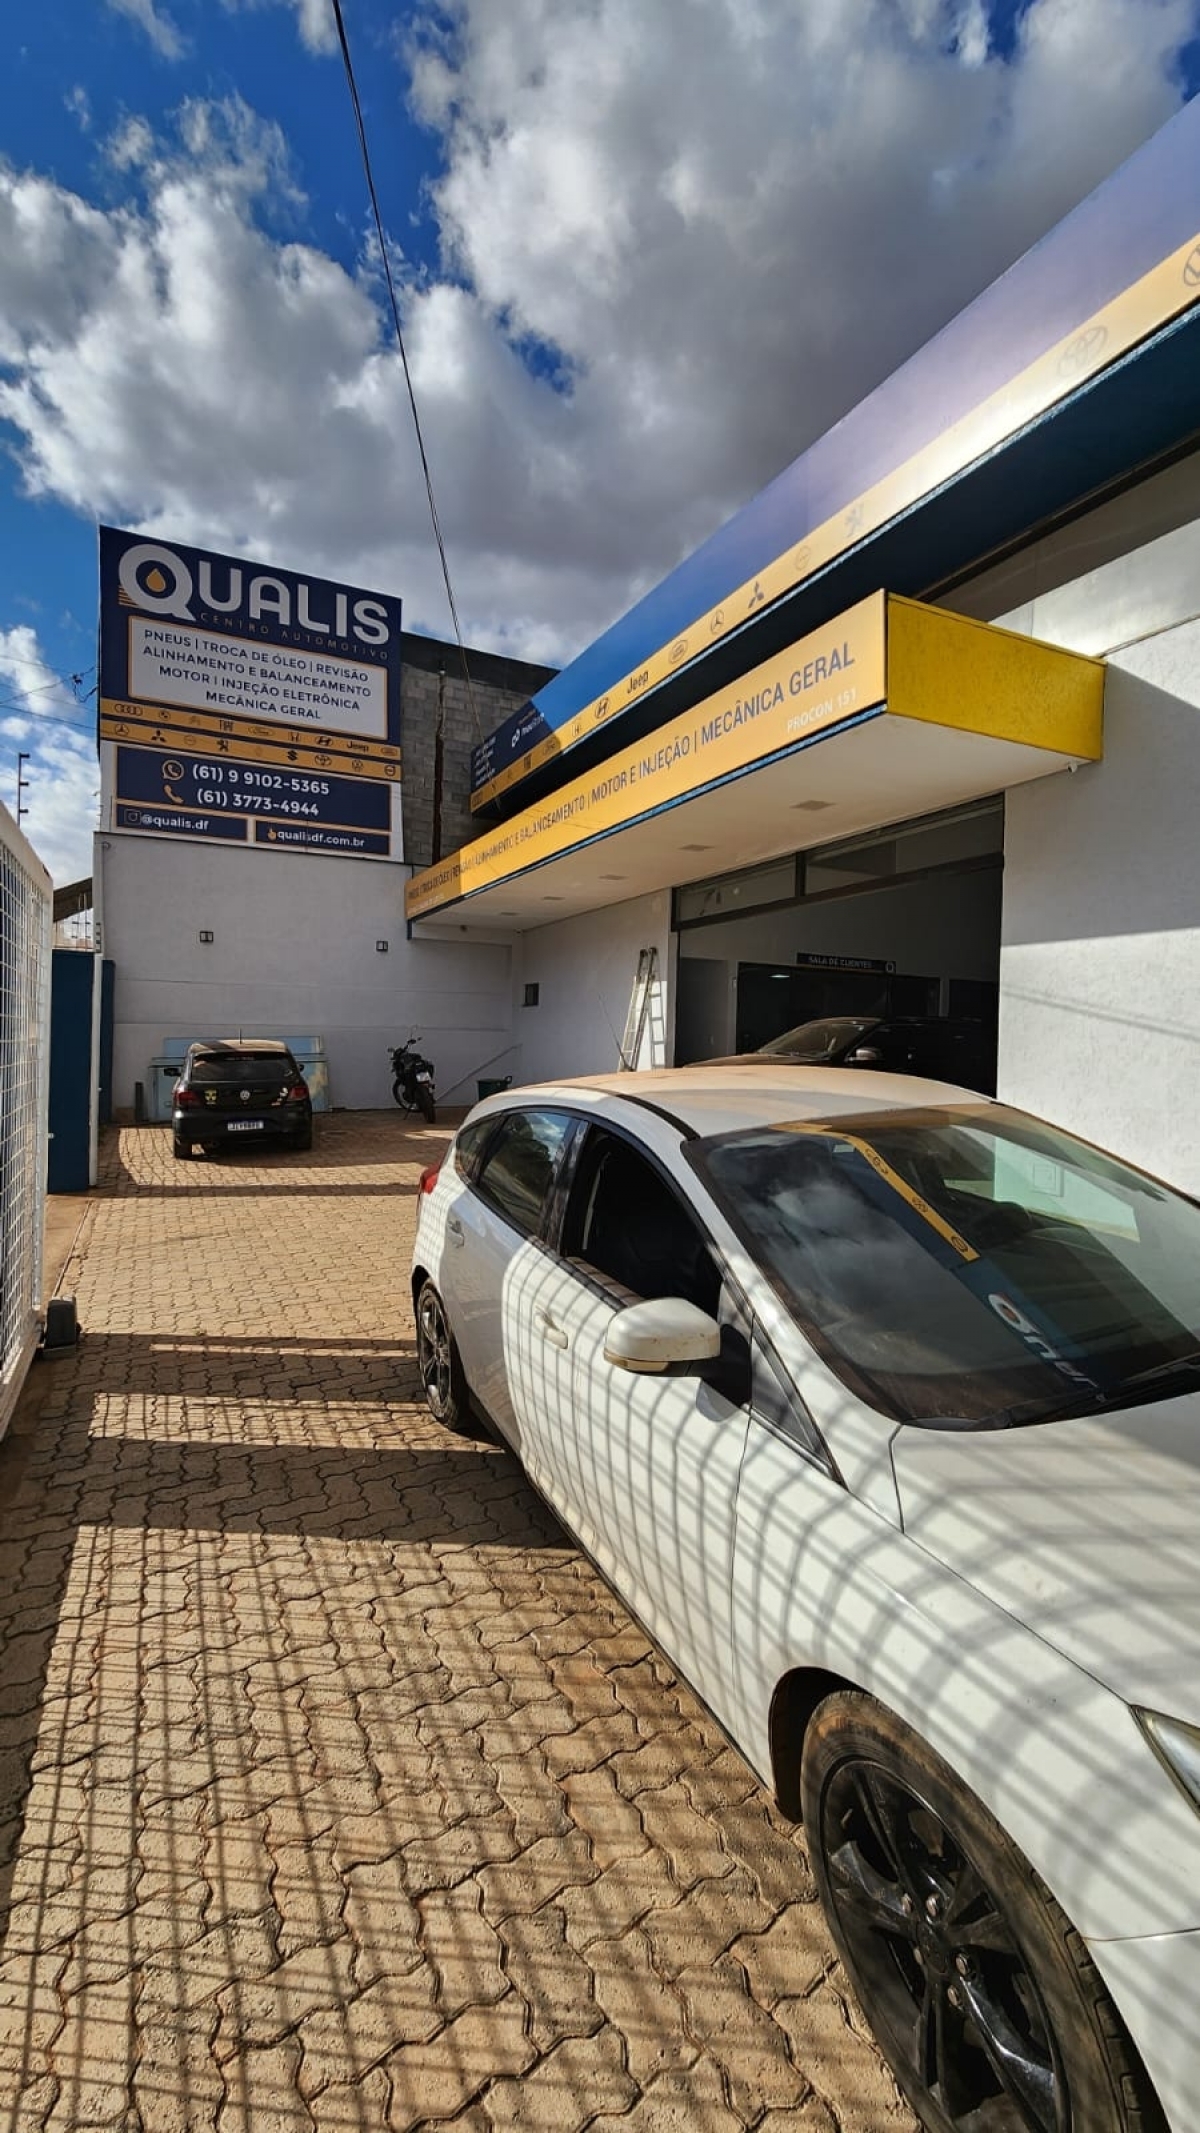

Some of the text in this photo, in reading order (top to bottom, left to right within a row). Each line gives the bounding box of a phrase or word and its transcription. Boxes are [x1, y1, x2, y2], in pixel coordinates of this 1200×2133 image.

[118, 543, 389, 645] QUALIS
[144, 629, 368, 682] PNEUS TROCA DE ÓLEO REVISÃO
[200, 612, 388, 660] CENTRO AUTOMOTIVO
[143, 645, 371, 697] ALINHAMENTO E BALANCEAMENTO
[159, 665, 360, 711] MOTOR INJEÇÃO ELETRÔNICA
[627, 670, 649, 695] Jeep
[206, 691, 321, 719] MECÂNICA GERAL
[592, 771, 628, 805] MOTOR
[630, 765, 636, 784] E
[638, 735, 690, 779] INJEÇÃO
[702, 682, 785, 746] MECÂNICA
[789, 642, 855, 697] GERAL
[192, 763, 330, 796] (61) 9 9102-5365
[140, 812, 209, 832] @qualis.df
[196, 788, 319, 817] (61) 3773-4944
[277, 829, 365, 848] qualisdf.com.br
